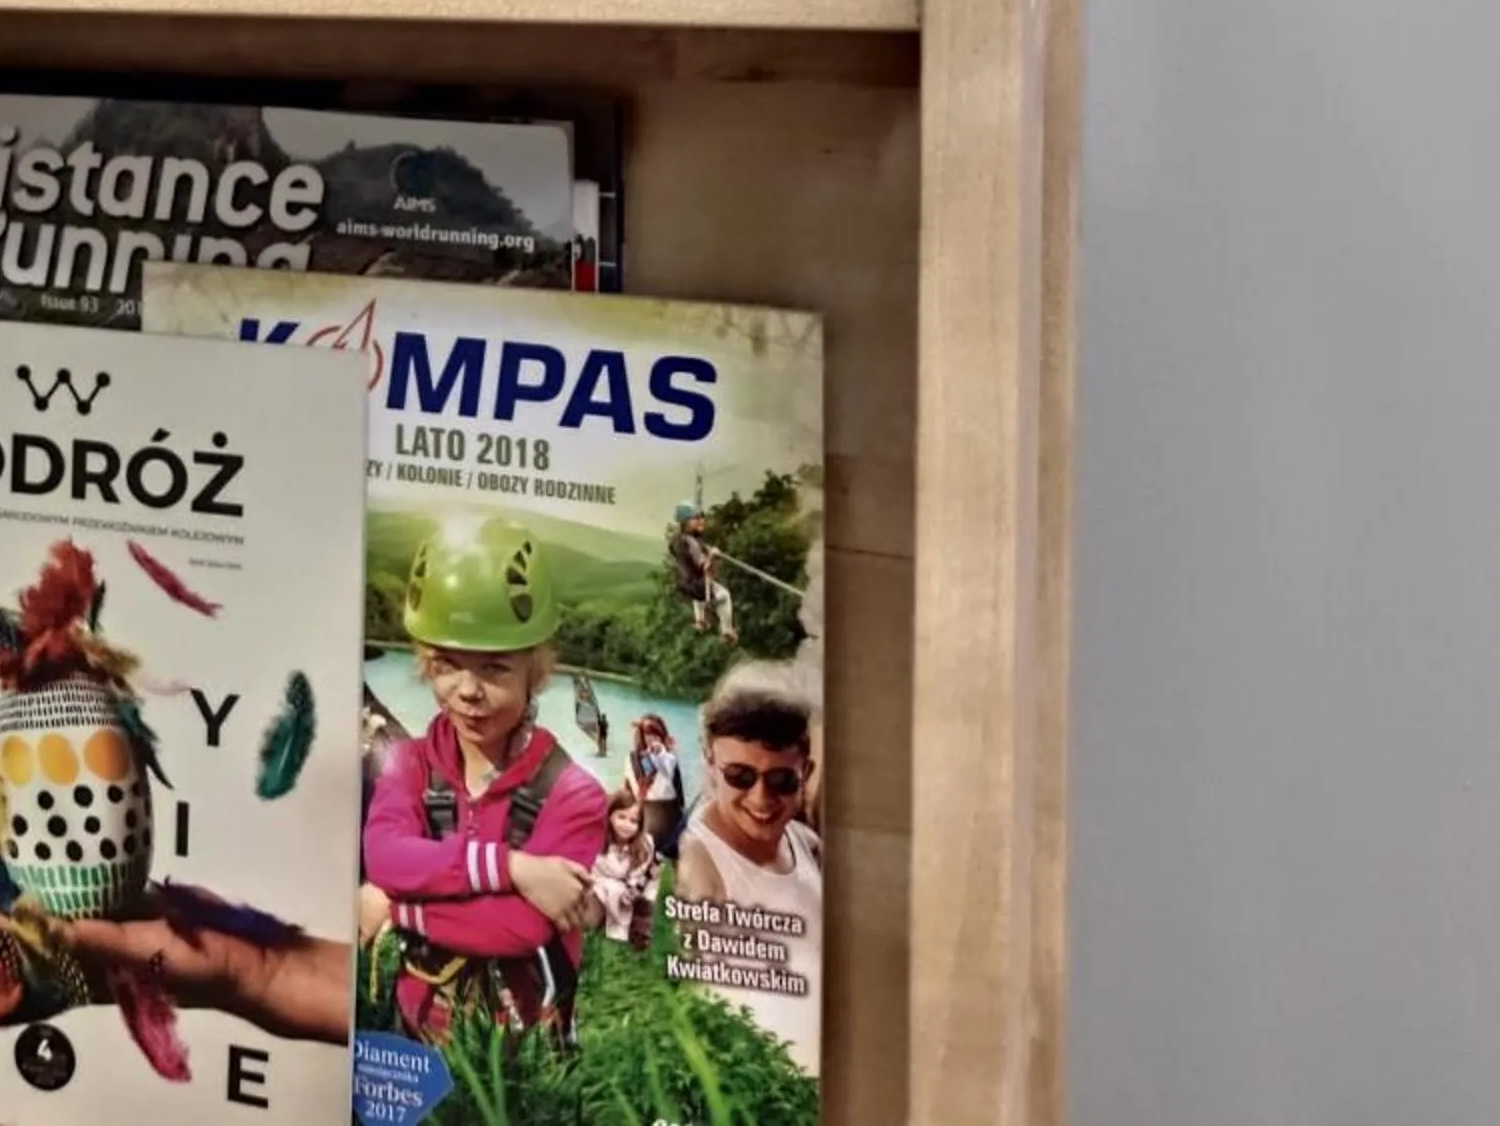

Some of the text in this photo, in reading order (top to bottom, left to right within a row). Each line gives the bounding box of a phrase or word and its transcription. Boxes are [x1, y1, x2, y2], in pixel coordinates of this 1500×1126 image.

[336, 218, 536, 253] aims-worldrunning.org
[239, 299, 718, 442] MPAS
[396, 423, 550, 471] LATO 2018
[397, 462, 464, 488] KOLONIE
[477, 470, 530, 496] OBOZY
[534, 476, 617, 506] RODZINNE
[190, 688, 241, 748] Y
[664, 895, 804, 935] Strefa Twórcza
[683, 929, 786, 961] z Dawidem
[667, 954, 806, 994] Kwiatkowskim
[226, 1043, 270, 1109] E
[355, 1039, 431, 1074] Diament
[354, 1075, 424, 1108] Forbes
[365, 1100, 407, 1123] 2017
